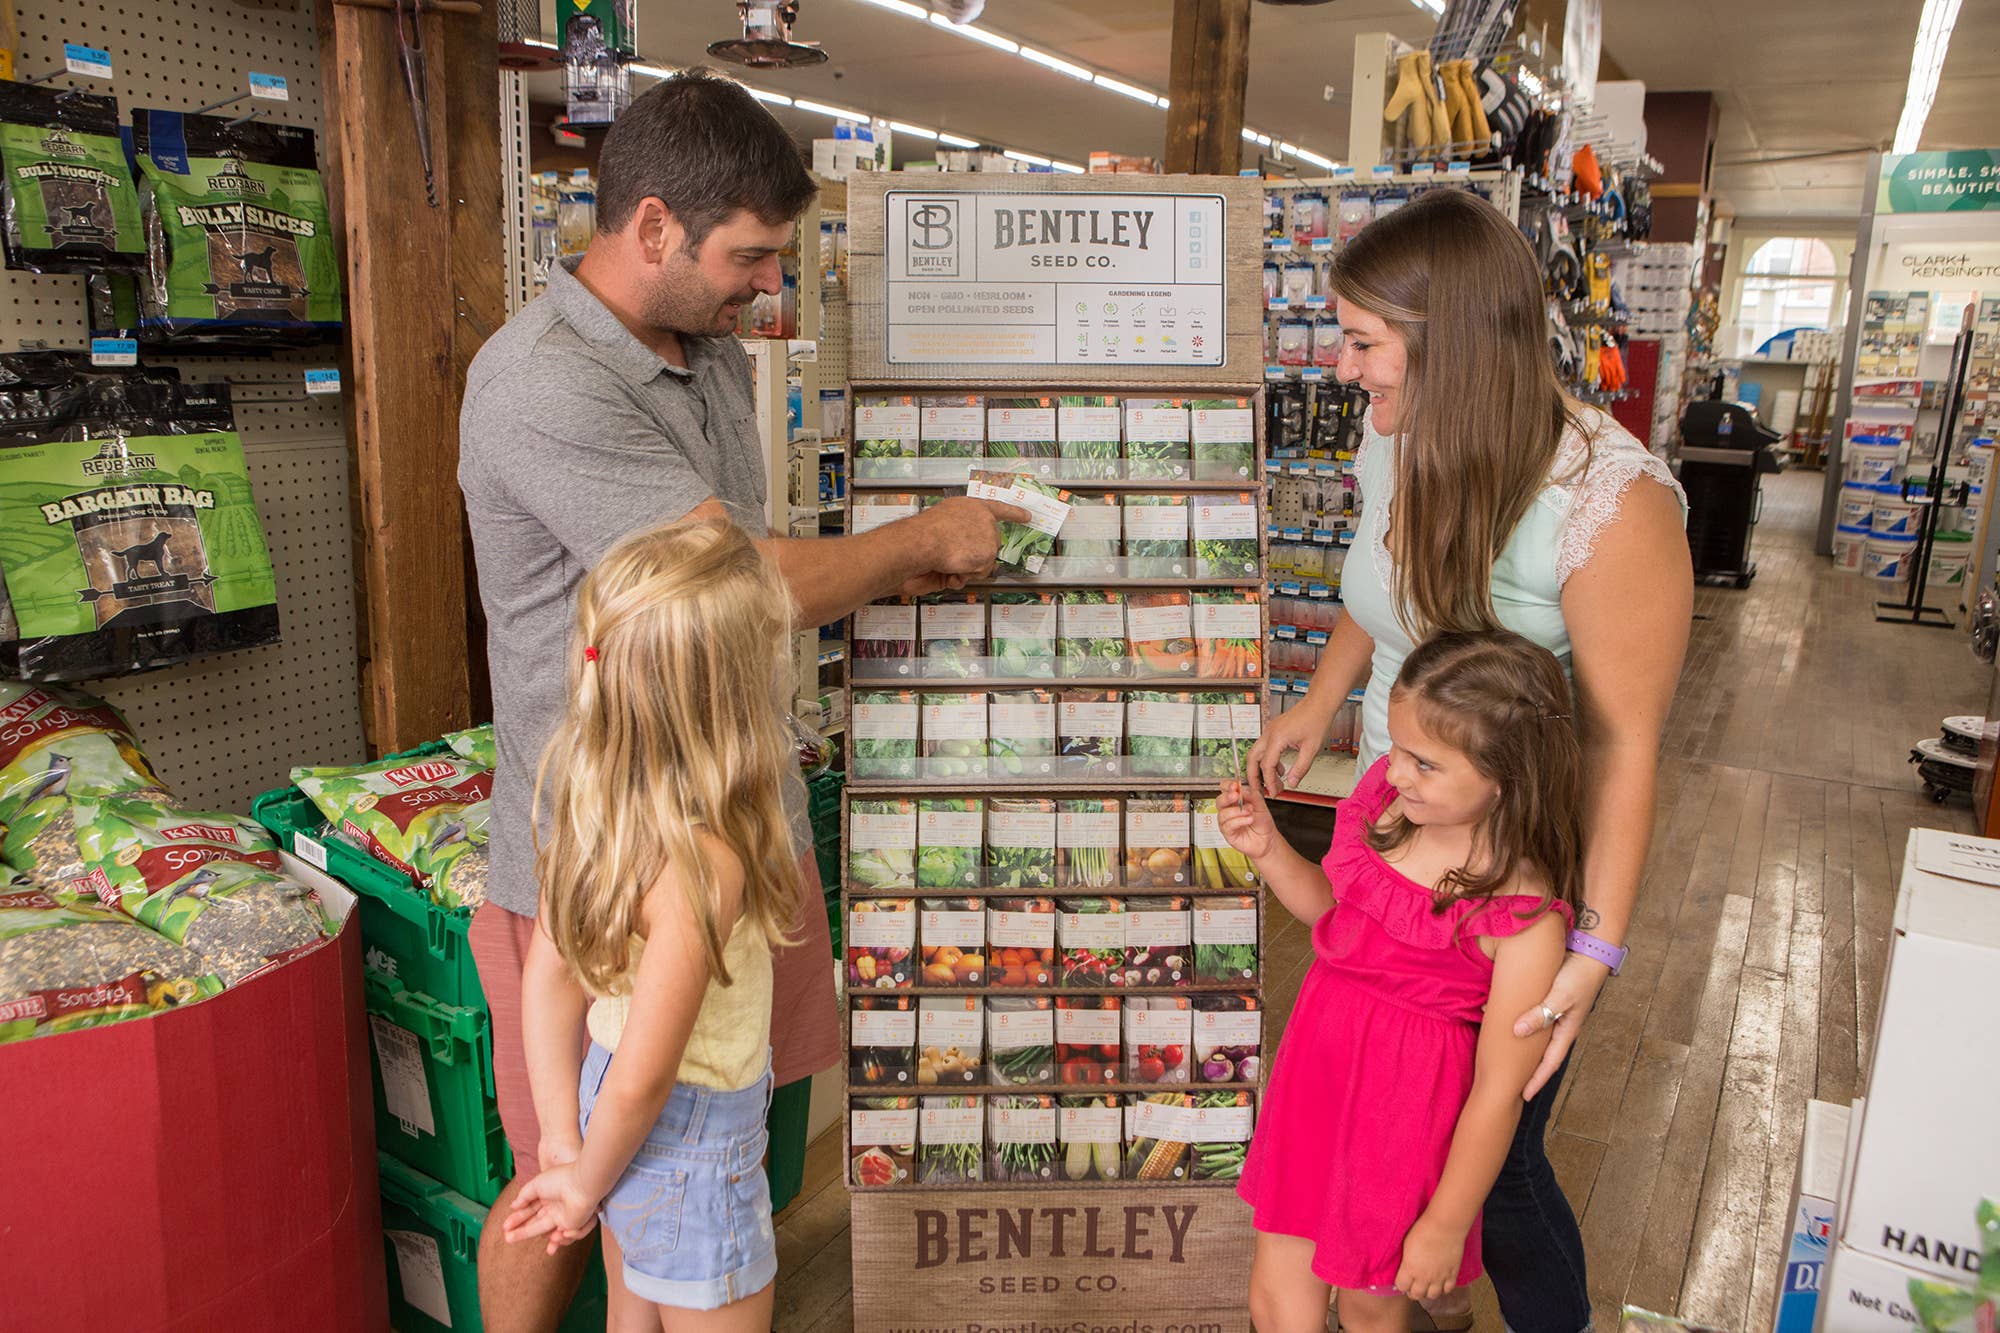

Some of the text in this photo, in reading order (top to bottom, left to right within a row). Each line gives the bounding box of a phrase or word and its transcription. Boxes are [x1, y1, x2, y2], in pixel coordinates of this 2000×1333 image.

[41, 140, 87, 154] REDBARN
[17, 164, 59, 179] BULLY
[207, 176, 266, 194] REDBARN
[1922, 181, 2000, 195] BEAUTIF
[177, 205, 316, 238] BULLY SLICES
[993, 208, 1154, 250] BENTLEY
[912, 256, 953, 268] BENTLEY
[1031, 255, 1116, 268] SEED CO.
[908, 291, 931, 300] NON
[973, 291, 1026, 300] HEIRLOOM
[908, 305, 1034, 314] OPEN POLLINATED SEEDS
[82, 455, 157, 475] REDBARN
[41, 486, 214, 524] BARGAIN BAG
[128, 584, 151, 593] TASTY
[166, 825, 233, 844] KAYTEE
[57, 985, 126, 1008] Songbird
[914, 1204, 1199, 1270] BENTLEY
[978, 1275, 1127, 1294] SEED CO.
